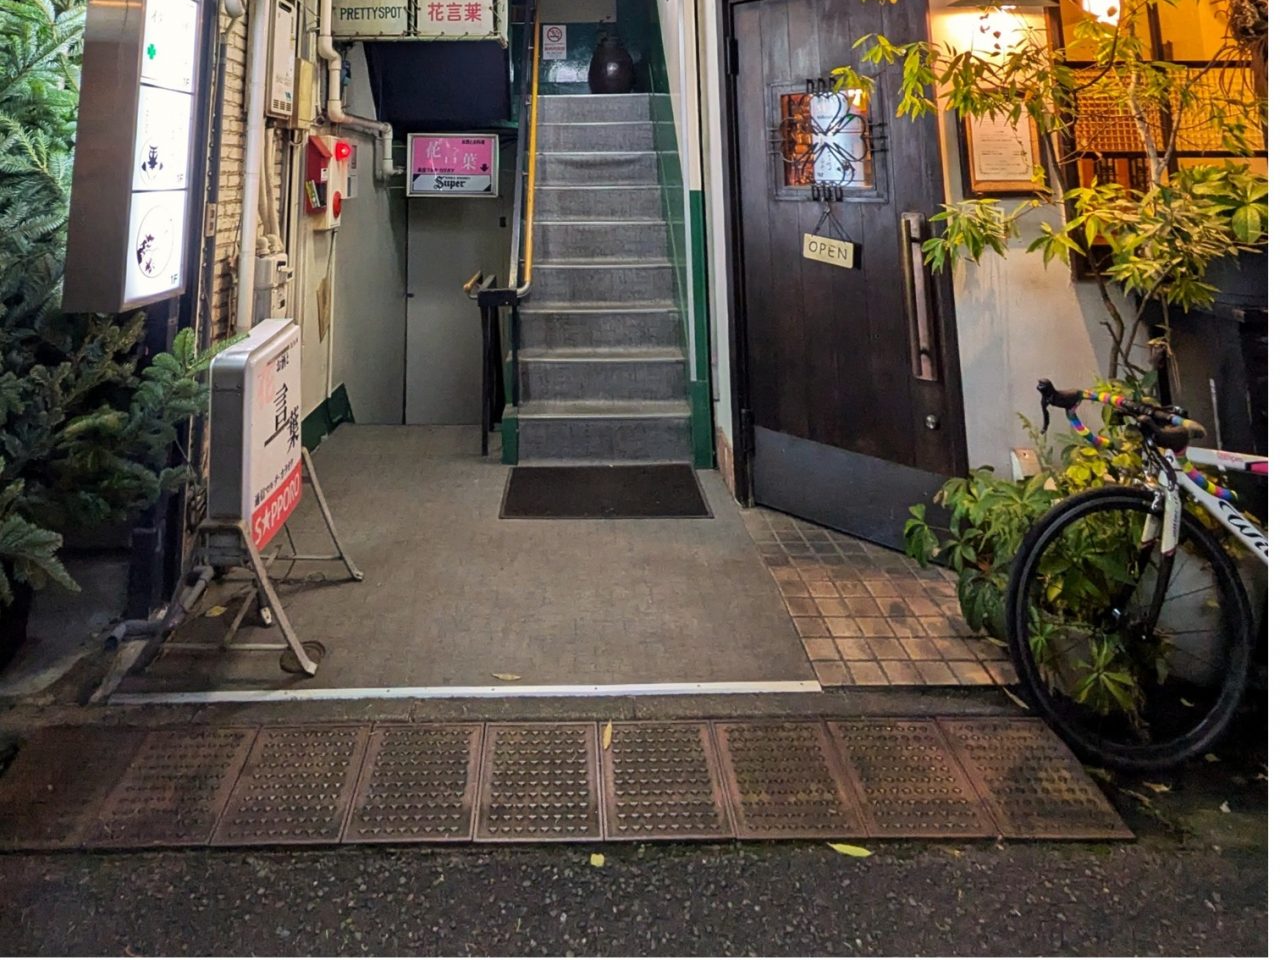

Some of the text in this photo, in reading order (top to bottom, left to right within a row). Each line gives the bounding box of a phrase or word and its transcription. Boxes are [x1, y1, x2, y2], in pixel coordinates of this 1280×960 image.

[427, 1, 482, 23] 花言葉
[433, 175, 467, 189] Super
[808, 240, 848, 261] OPEN
